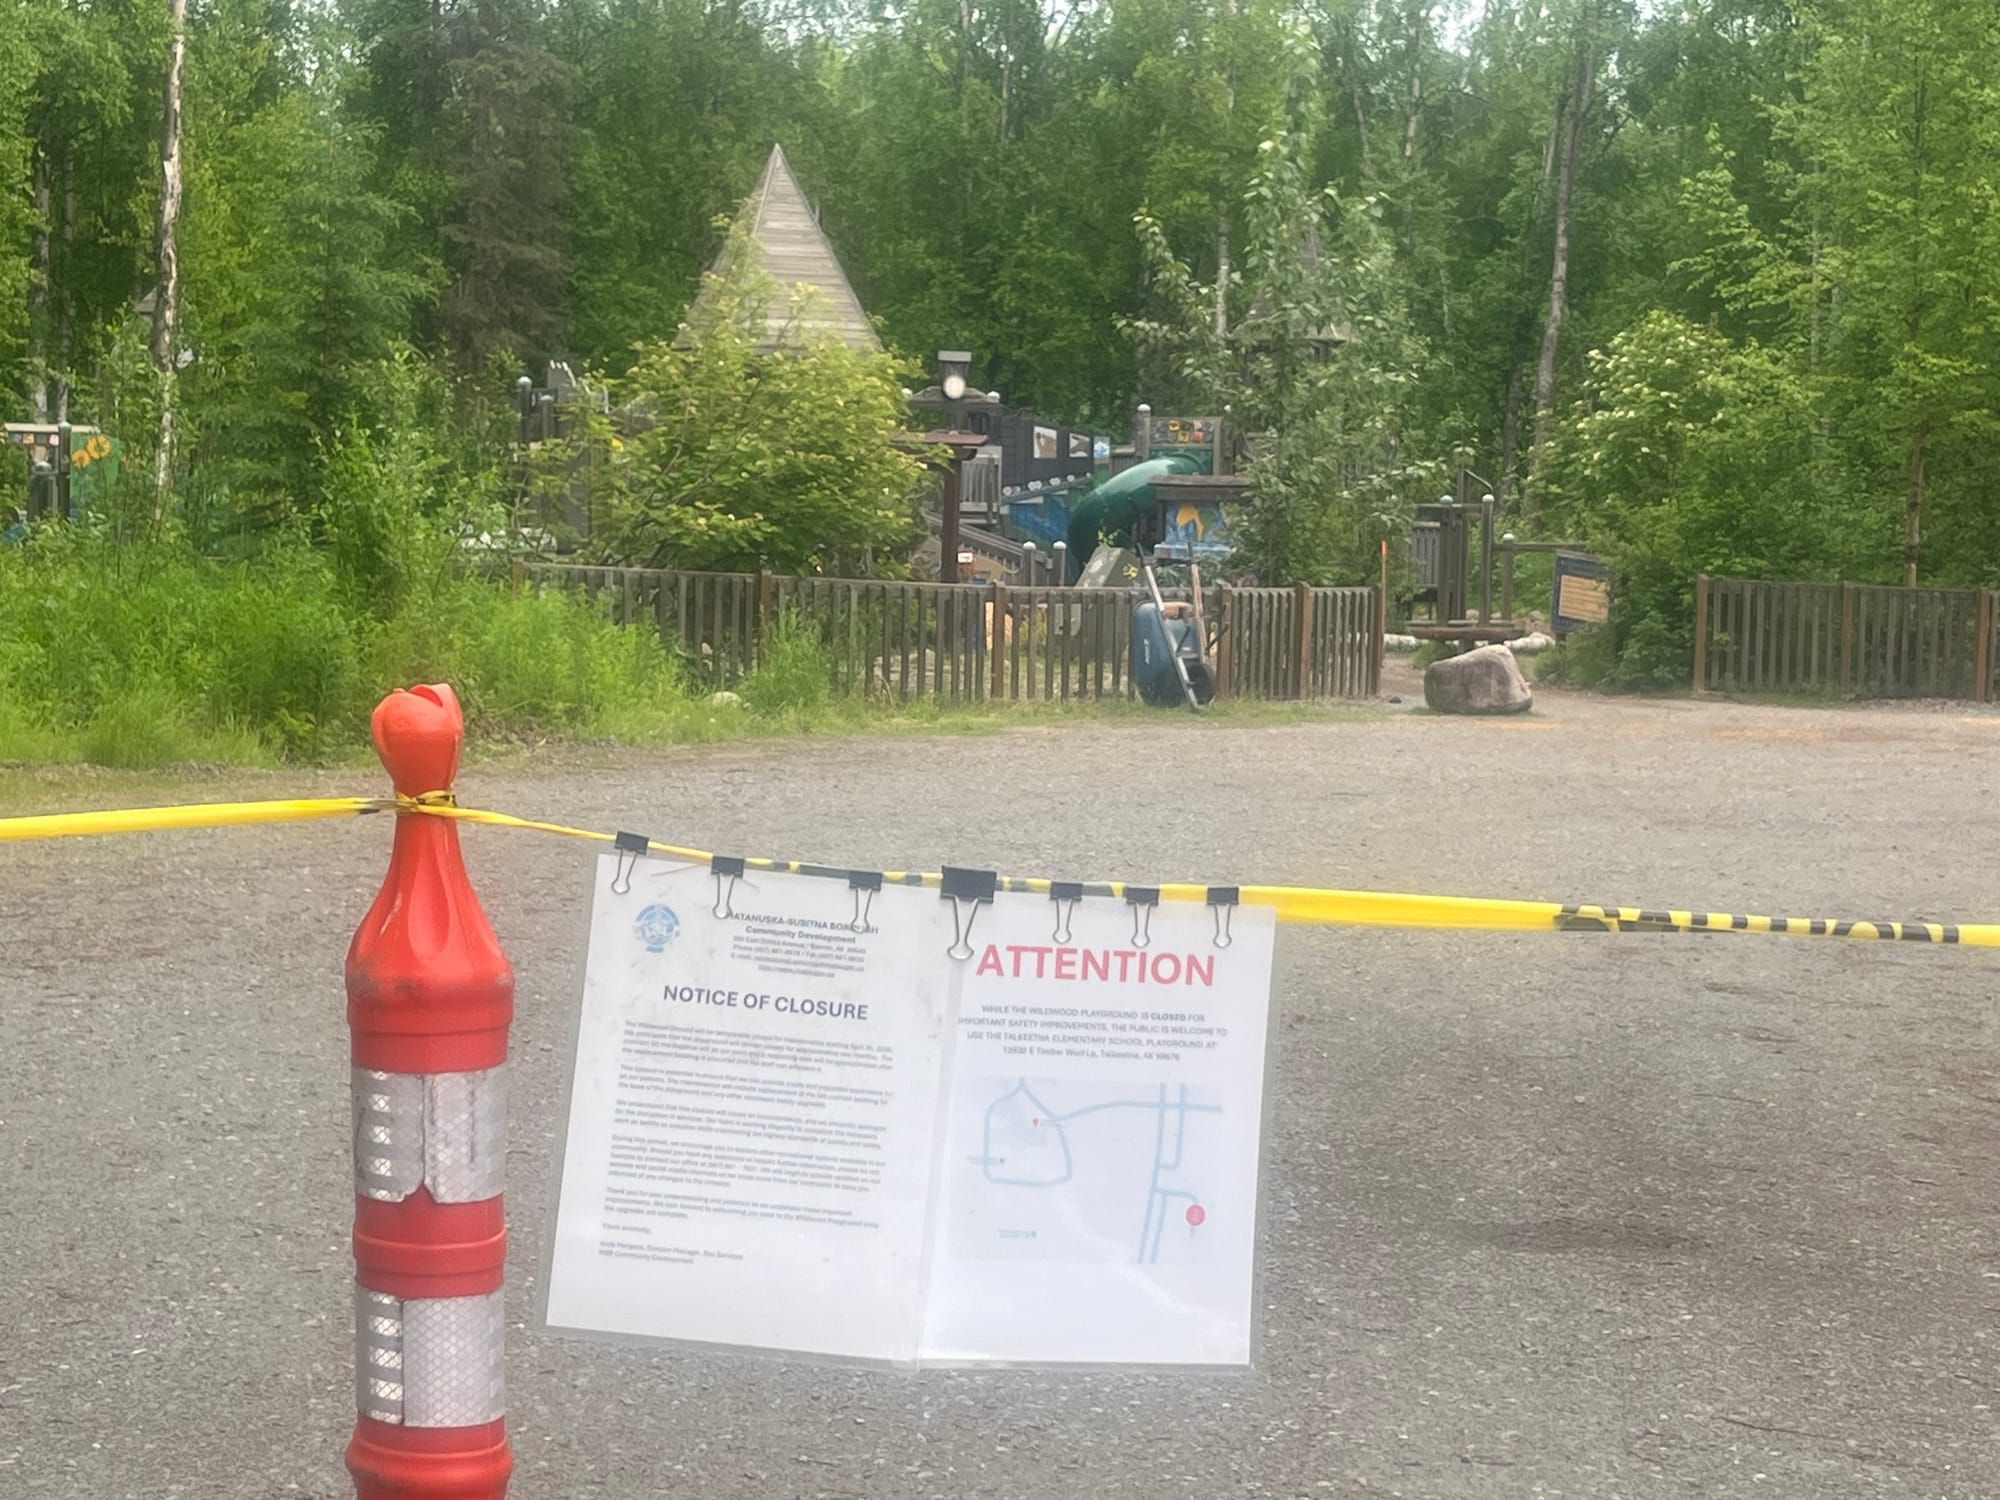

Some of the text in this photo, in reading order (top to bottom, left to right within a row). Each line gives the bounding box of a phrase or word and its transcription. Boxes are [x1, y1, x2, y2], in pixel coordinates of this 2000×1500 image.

[745, 925, 856, 943] Community Development
[976, 944, 1214, 986] ATTENTION
[664, 985, 868, 1020] NOTICE OF CLOSURE
[981, 1005, 1009, 1014] WHILE
[1011, 1005, 1027, 1014] THE
[1029, 1007, 1078, 1016] WILDWOOD
[1080, 1008, 1138, 1020] PLAYGROUND
[1151, 1012, 1186, 1021] CLOSED
[1188, 1013, 1205, 1022] FOR
[958, 1017, 1006, 1027] IMPORTANT
[1008, 1018, 1038, 1028] SAFETY
[1111, 1023, 1127, 1032] THE
[1129, 1024, 1160, 1033] PUBLIC
[1170, 1026, 1214, 1036] WELCOME
[967, 1031, 984, 1040] USE
[986, 1032, 1002, 1040] THE
[1004, 1032, 1050, 1042] TALKEETNA
[1146, 1039, 1203, 1048] PLAYGROUND
